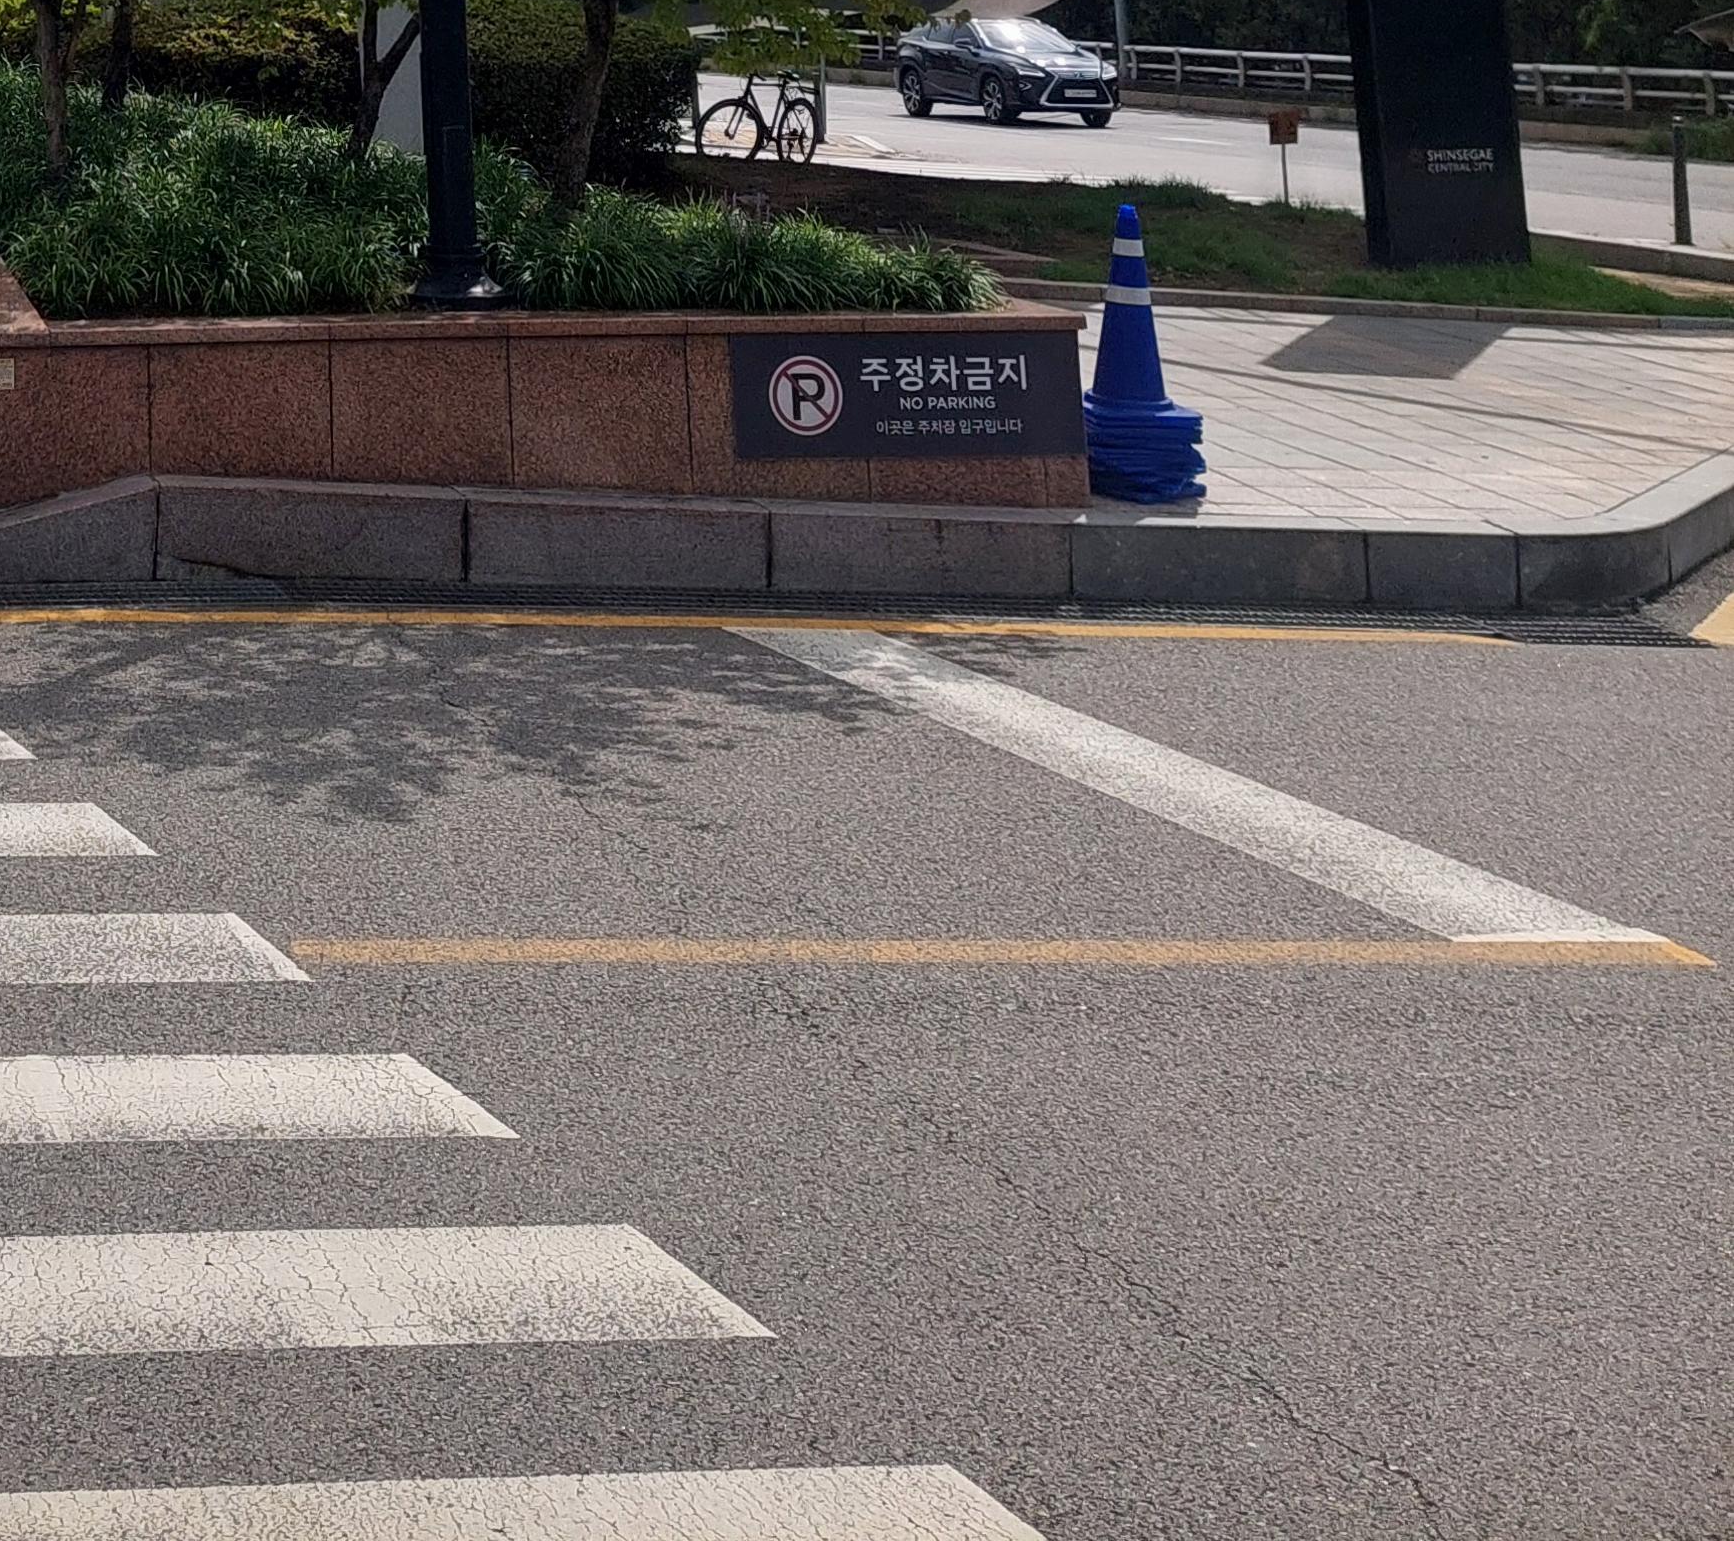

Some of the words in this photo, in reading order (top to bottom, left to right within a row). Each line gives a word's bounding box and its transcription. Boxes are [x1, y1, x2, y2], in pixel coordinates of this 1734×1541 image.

[1426, 148, 1494, 162] SHINSEGAE
[1427, 162, 1471, 174] CENTRAL
[1473, 161, 1495, 173] CITY
[860, 354, 1028, 392] 주정차금지
[899, 396, 923, 410] NO
[927, 395, 997, 410] PARKING
[876, 420, 914, 435] 이곳은
[918, 420, 955, 435] 주차장
[959, 419, 1023, 435] 입구입니다
